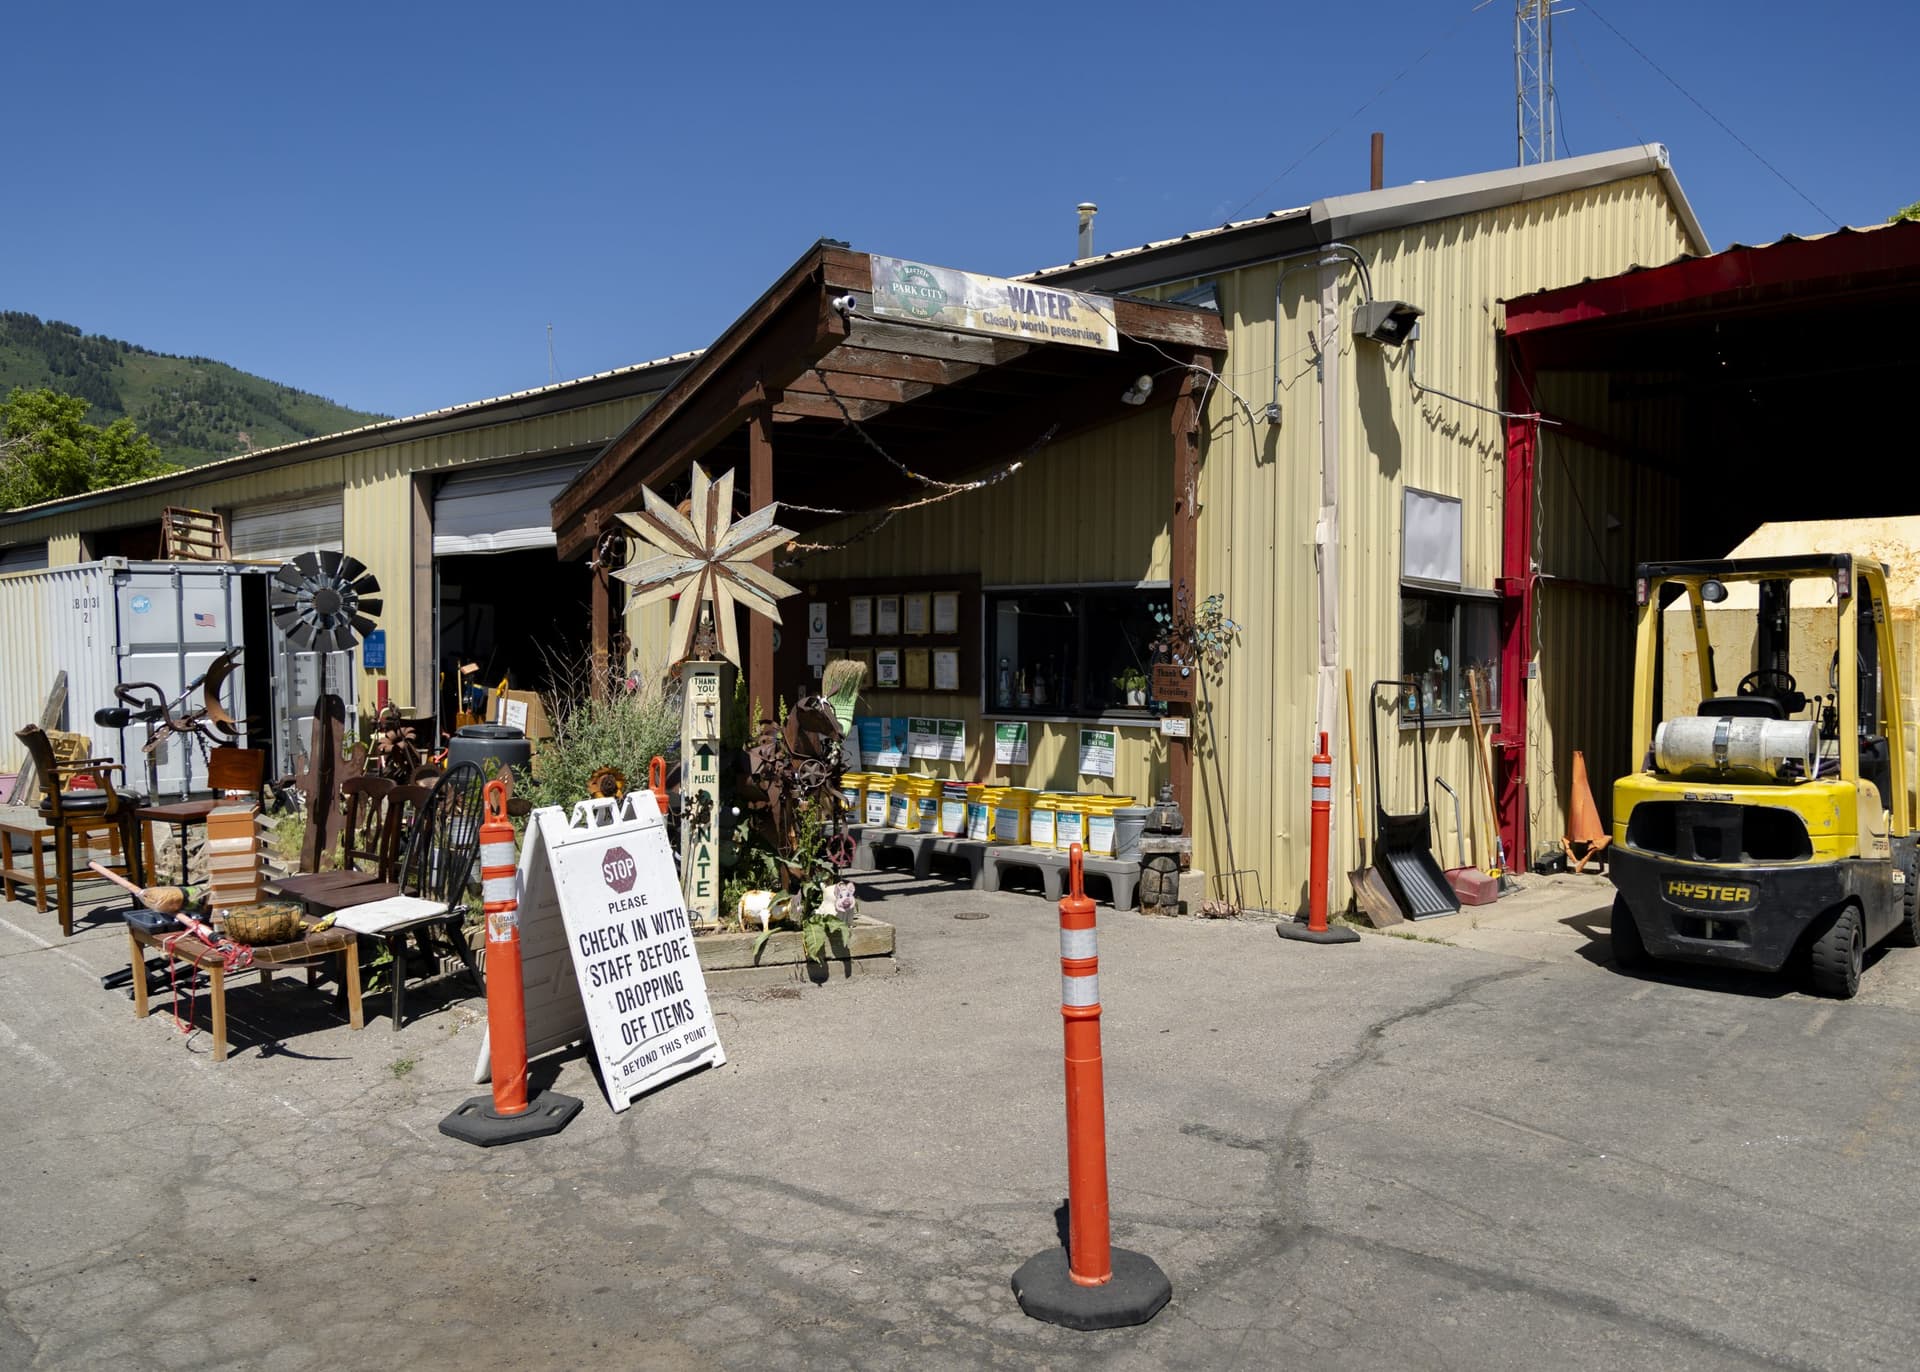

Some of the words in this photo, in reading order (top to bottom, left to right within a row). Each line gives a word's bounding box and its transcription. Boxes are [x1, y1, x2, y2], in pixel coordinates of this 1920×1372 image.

[892, 282, 918, 296] PARK
[920, 287, 944, 299] CITY
[1007, 285, 1078, 322] WATER.
[983, 312, 1018, 331] Clearly
[1020, 319, 1049, 334] worth
[1051, 326, 1104, 344] preserving.
[694, 678, 717, 687] THANK
[697, 685, 715, 694] YOU
[694, 774, 716, 784] PLEASE
[697, 790, 711, 898] NATE
[603, 860, 635, 884] STOP
[608, 894, 649, 914] PLEASE
[1668, 881, 1751, 902] HYSTER
[579, 927, 627, 957] CHECK
[633, 920, 649, 942] IN
[651, 907, 686, 937] WITH
[590, 953, 633, 987] STAFF
[639, 936, 690, 972] BEFORE
[615, 970, 684, 1014] DROPPING
[621, 1014, 647, 1046] OFF
[651, 998, 695, 1035] ITEMS
[622, 1048, 659, 1077] BEYOND
[659, 1038, 683, 1060] THIS
[683, 1026, 707, 1048] POINT
